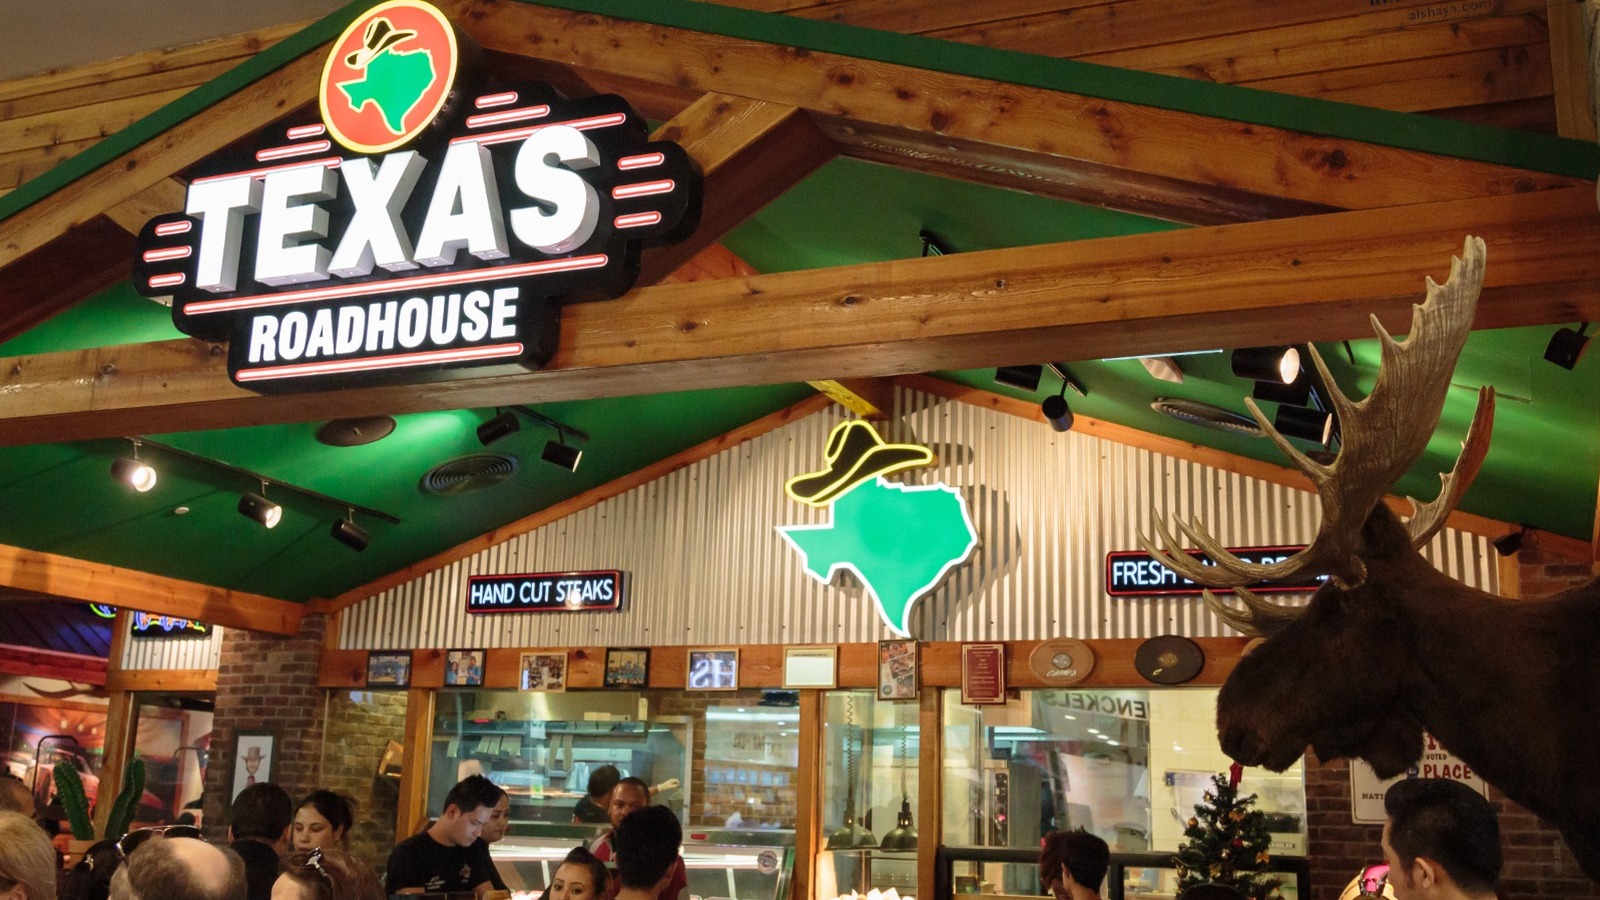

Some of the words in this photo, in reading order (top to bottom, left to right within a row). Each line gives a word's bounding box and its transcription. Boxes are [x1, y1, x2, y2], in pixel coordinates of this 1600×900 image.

[187, 125, 599, 292] TEXAS
[248, 287, 519, 363] ROADHOUSE
[1112, 560, 1177, 586] FRESH
[470, 582, 515, 605] HAND
[519, 581, 552, 603] CUT
[556, 578, 613, 602] STEAKS
[1425, 753, 1448, 761] VOTED
[1423, 764, 1472, 779] PLACE
